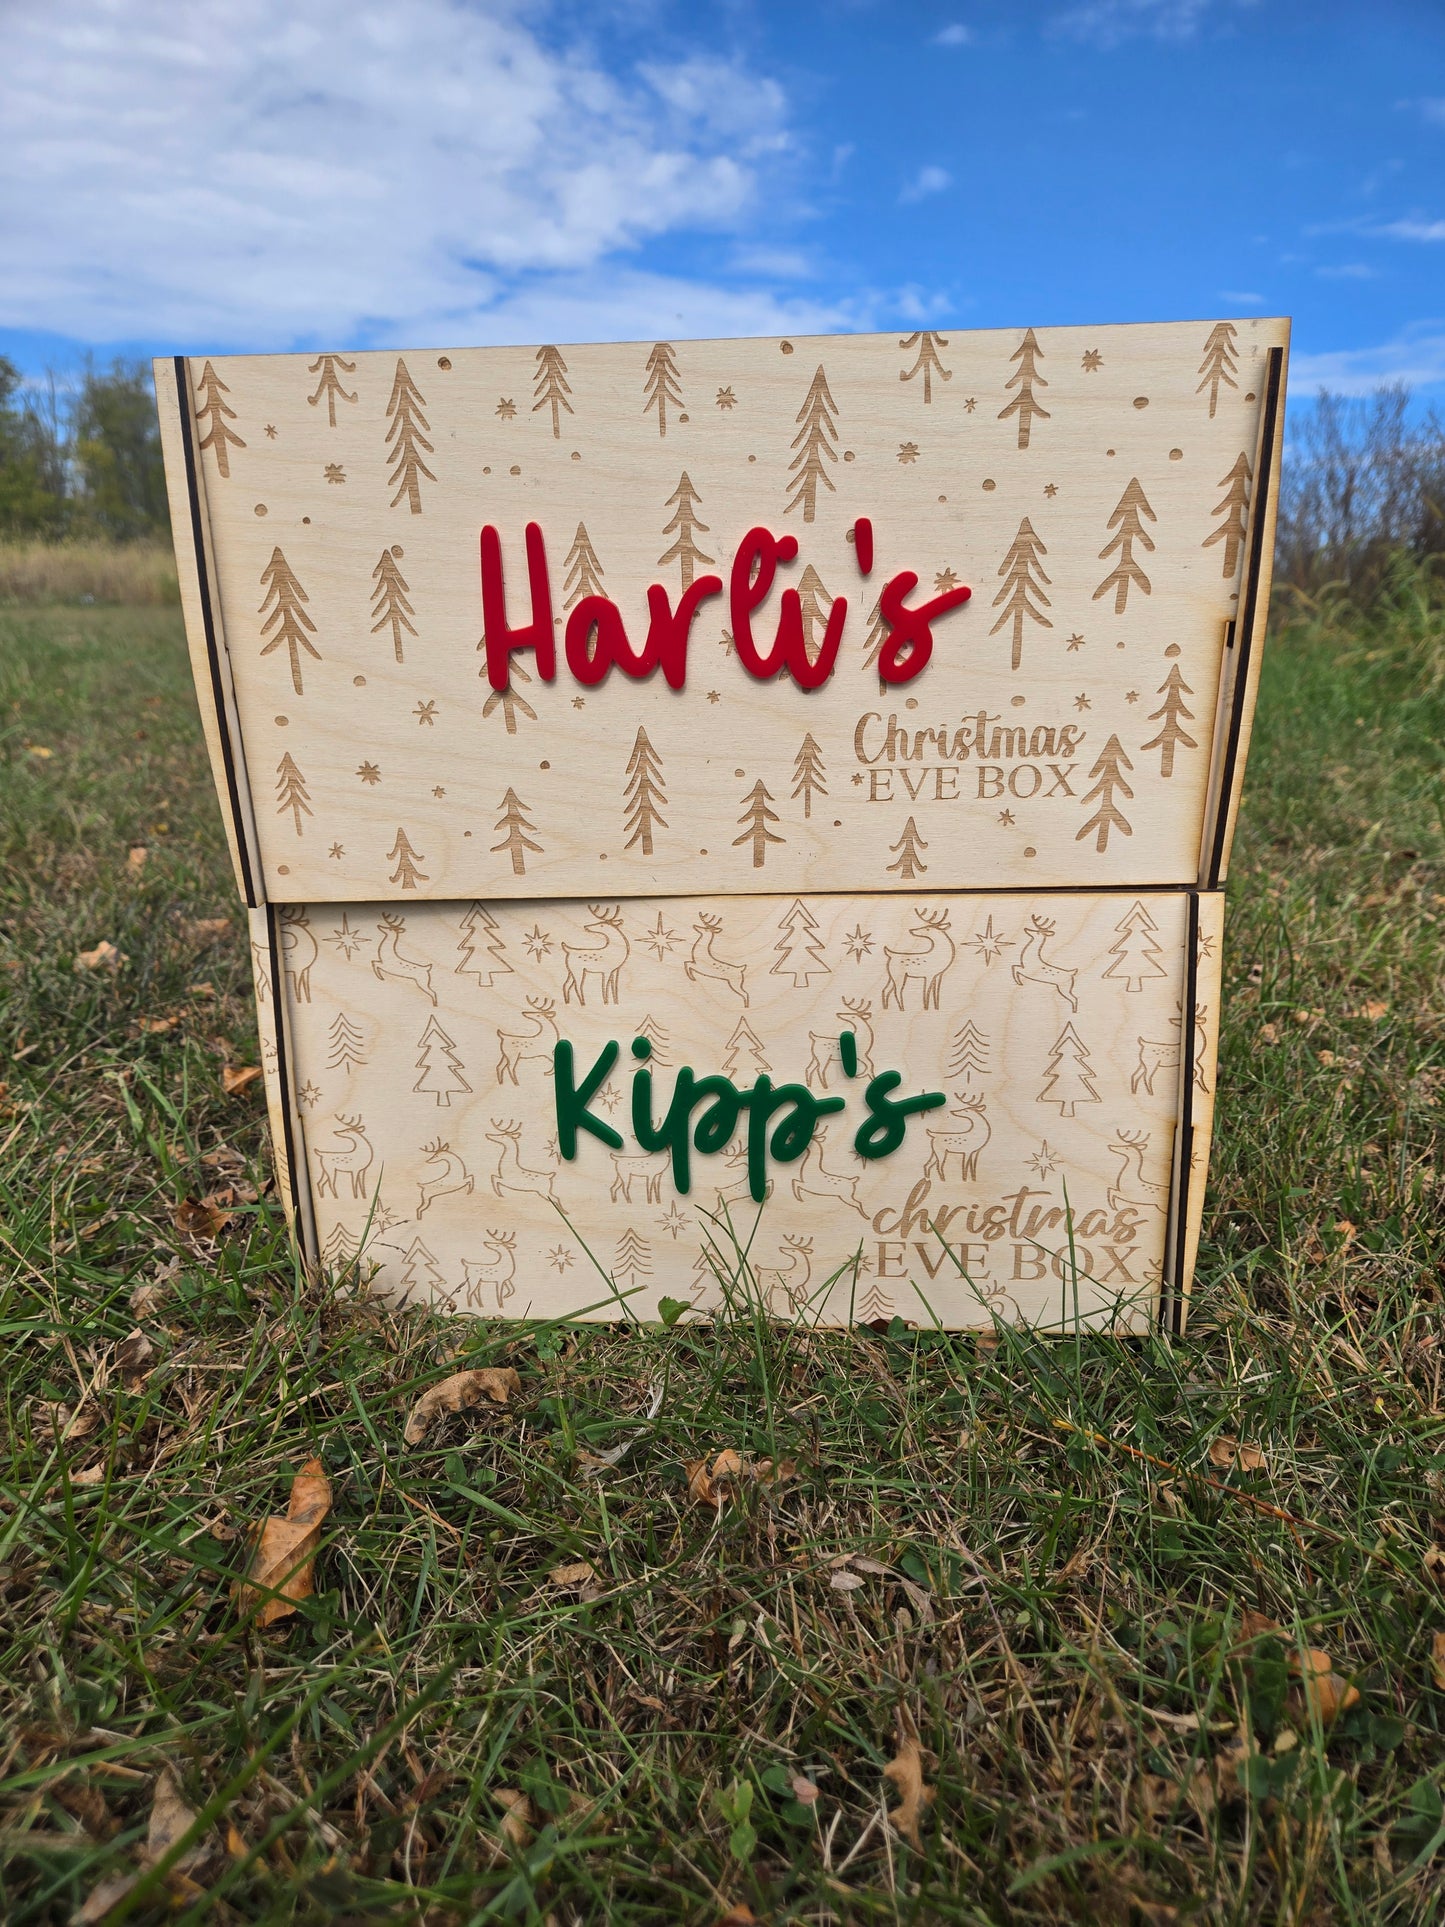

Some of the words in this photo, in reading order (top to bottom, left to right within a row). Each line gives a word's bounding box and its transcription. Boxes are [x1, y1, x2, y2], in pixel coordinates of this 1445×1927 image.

[480, 517, 972, 690] Harli's
[854, 710, 1087, 764] Christmas
[866, 766, 960, 802] EVE
[974, 763, 1080, 799] BOX
[554, 1030, 946, 1203] Kipp's
[872, 1177, 1149, 1244] christmas
[873, 1241, 991, 1281] EVE
[1008, 1243, 1142, 1283] BOX
